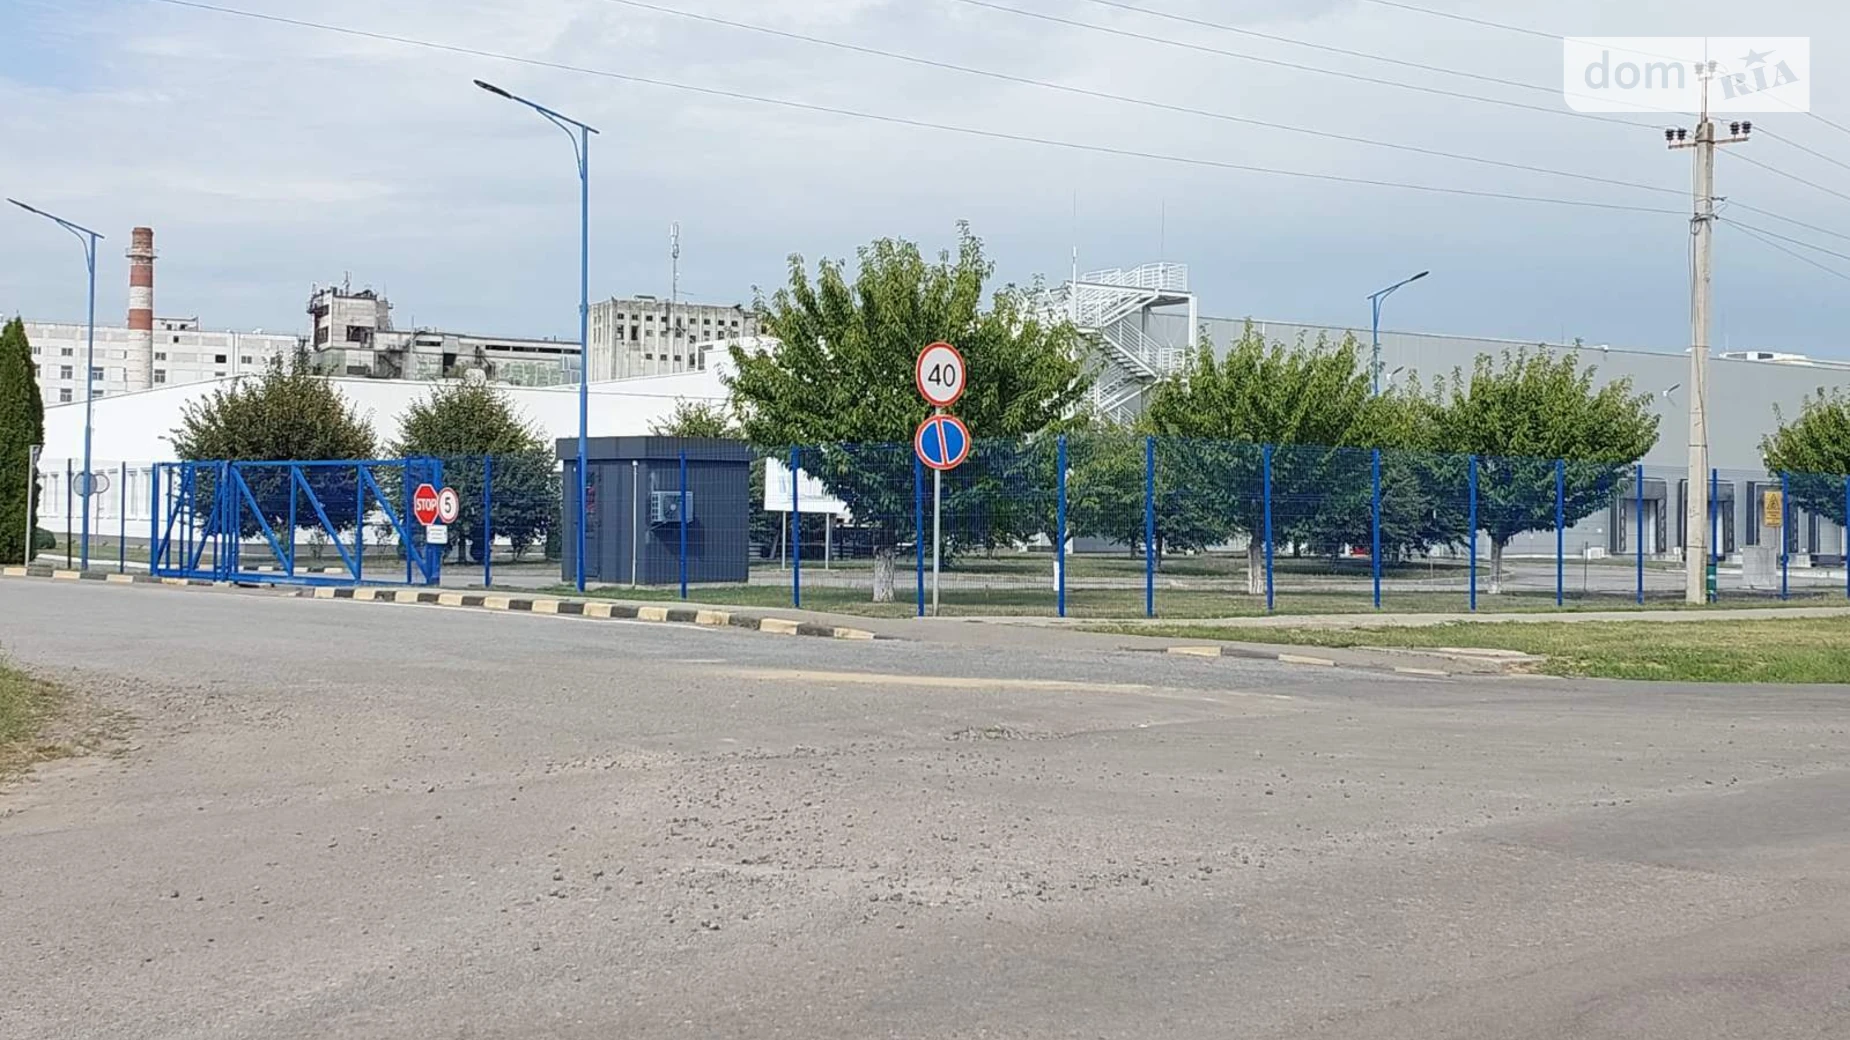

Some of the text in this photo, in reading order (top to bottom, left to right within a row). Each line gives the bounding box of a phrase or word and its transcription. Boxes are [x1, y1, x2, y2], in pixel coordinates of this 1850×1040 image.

[928, 363, 956, 387] 40
[416, 498, 437, 512] STOP
[444, 497, 452, 513] 5
